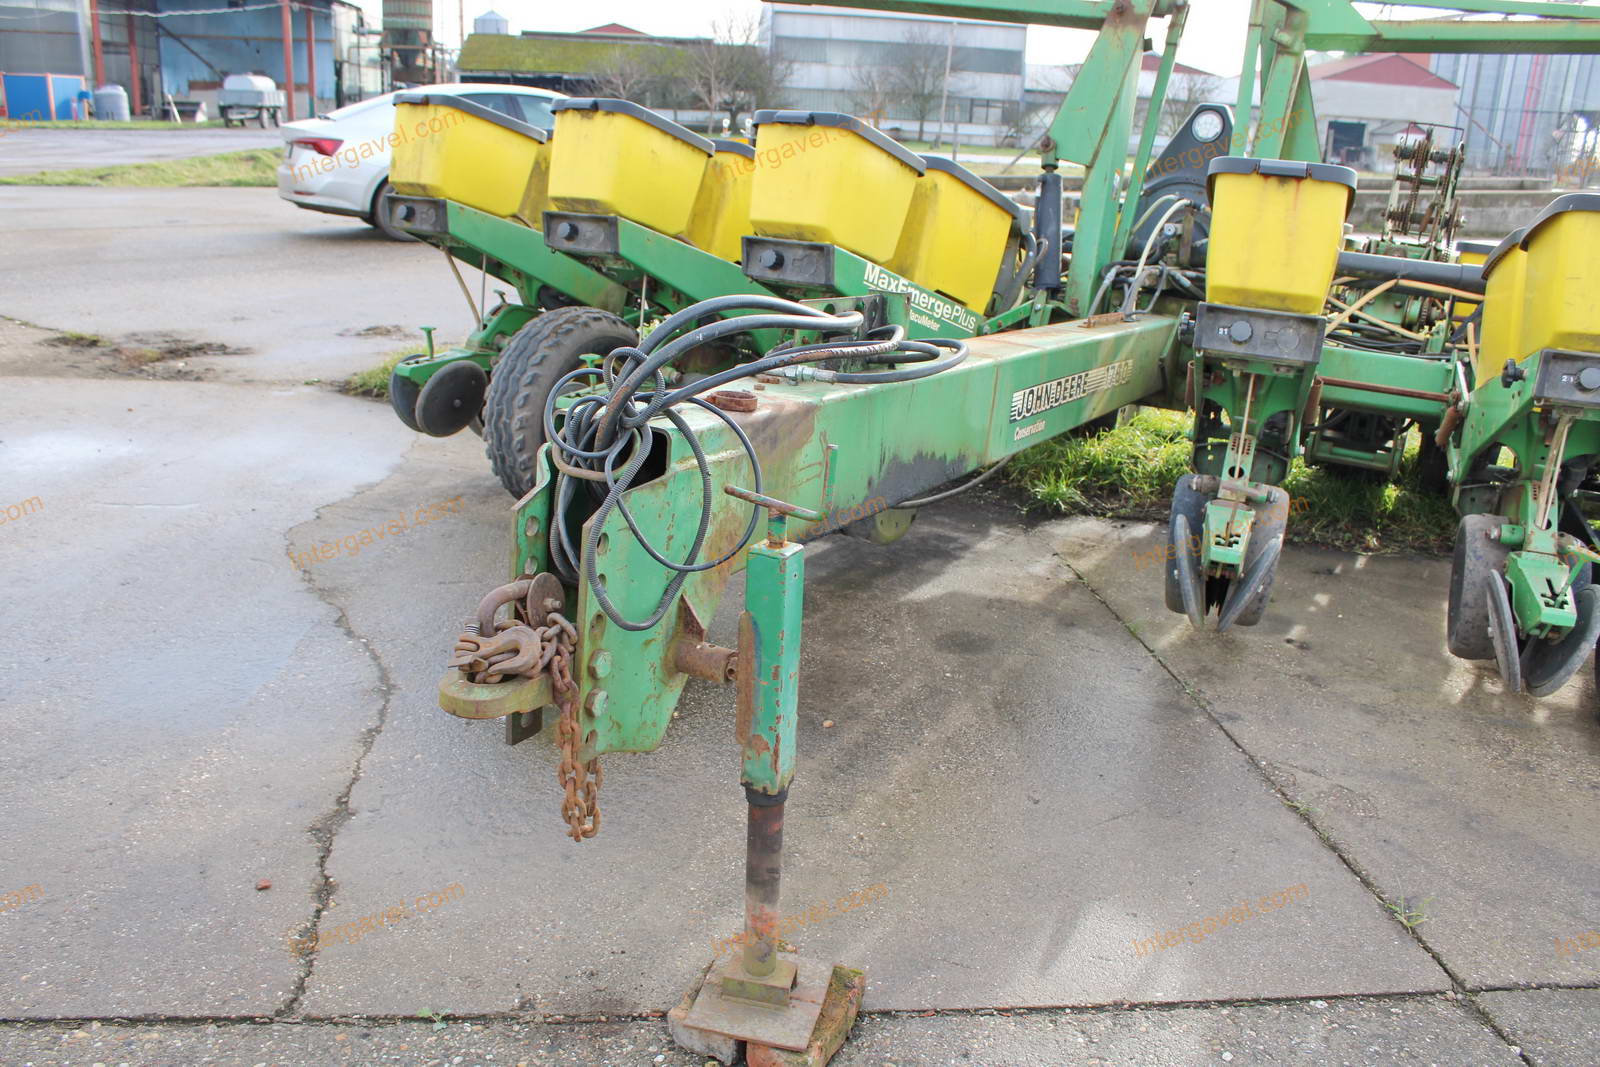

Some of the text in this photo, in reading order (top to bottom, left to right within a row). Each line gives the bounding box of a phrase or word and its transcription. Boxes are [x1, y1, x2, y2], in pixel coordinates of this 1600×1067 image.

[1016, 382, 1053, 419] JOHN
[1054, 372, 1089, 404] DEERE
[1014, 420, 1046, 441] Conservation
